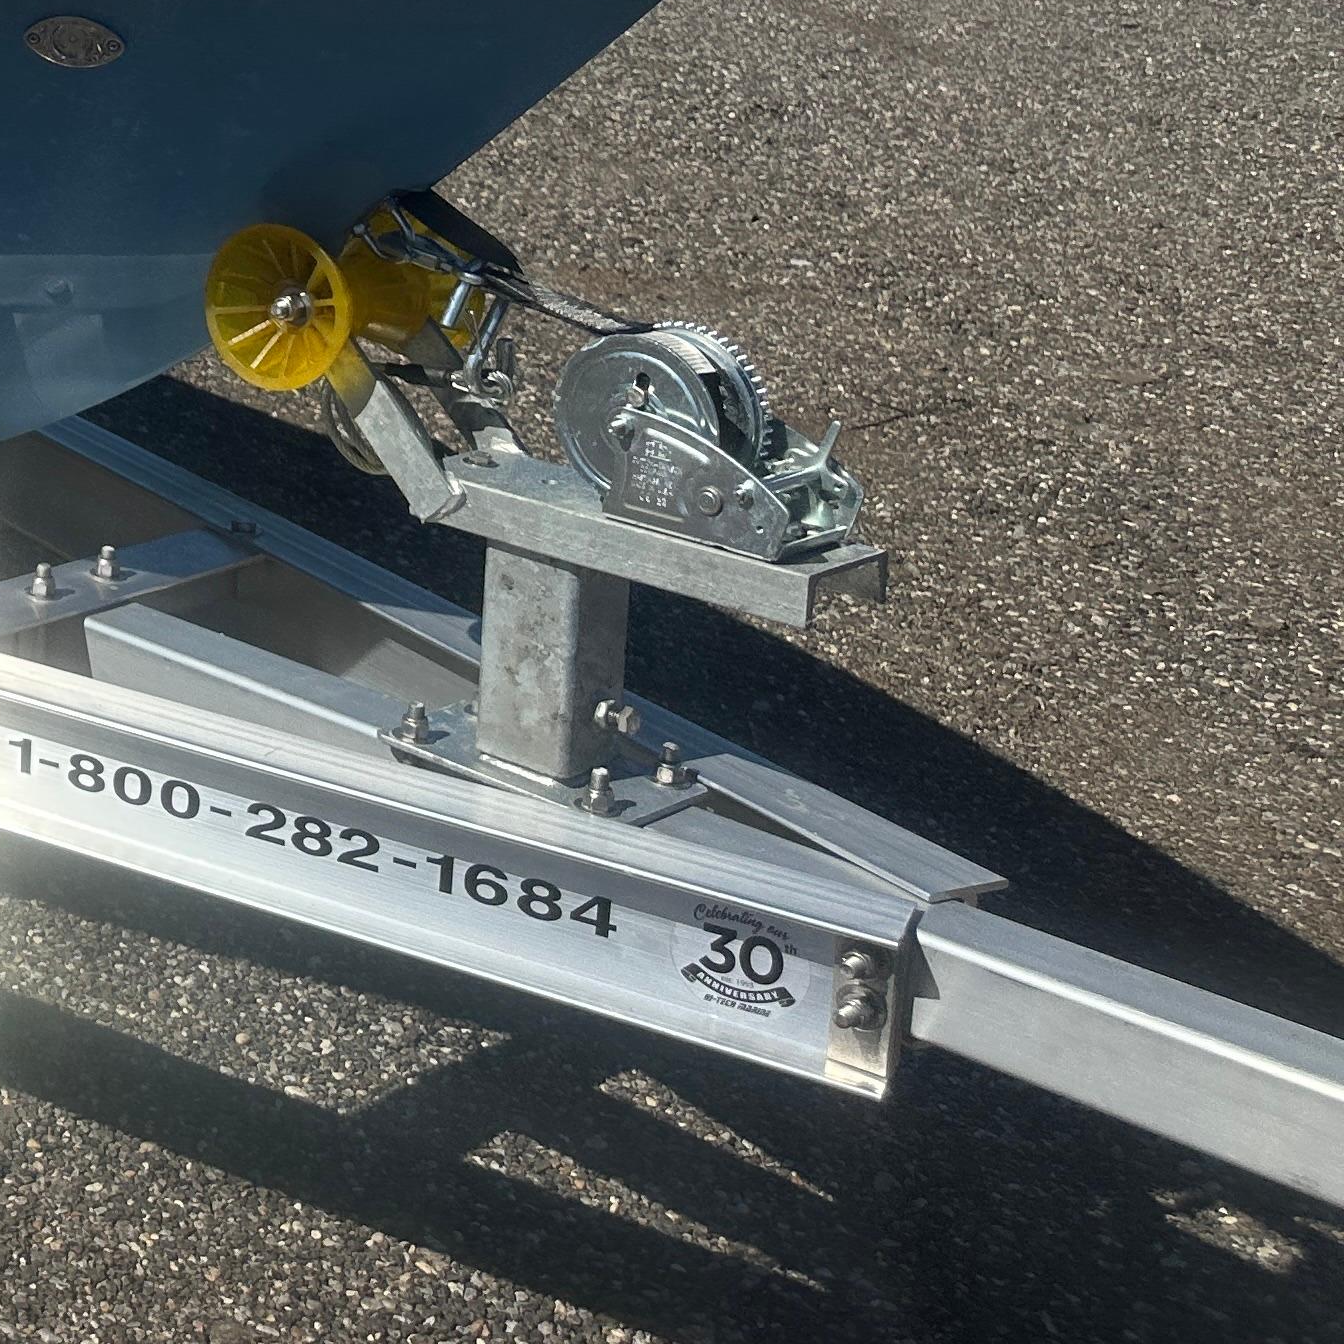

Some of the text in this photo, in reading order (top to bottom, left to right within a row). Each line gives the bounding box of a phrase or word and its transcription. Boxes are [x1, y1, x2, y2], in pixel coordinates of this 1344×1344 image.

[8, 738, 618, 938] 1-800-282-1684
[693, 903, 764, 934] Celebrating
[699, 922, 784, 985] 30
[696, 971, 780, 1001] ANNIVERSARY
